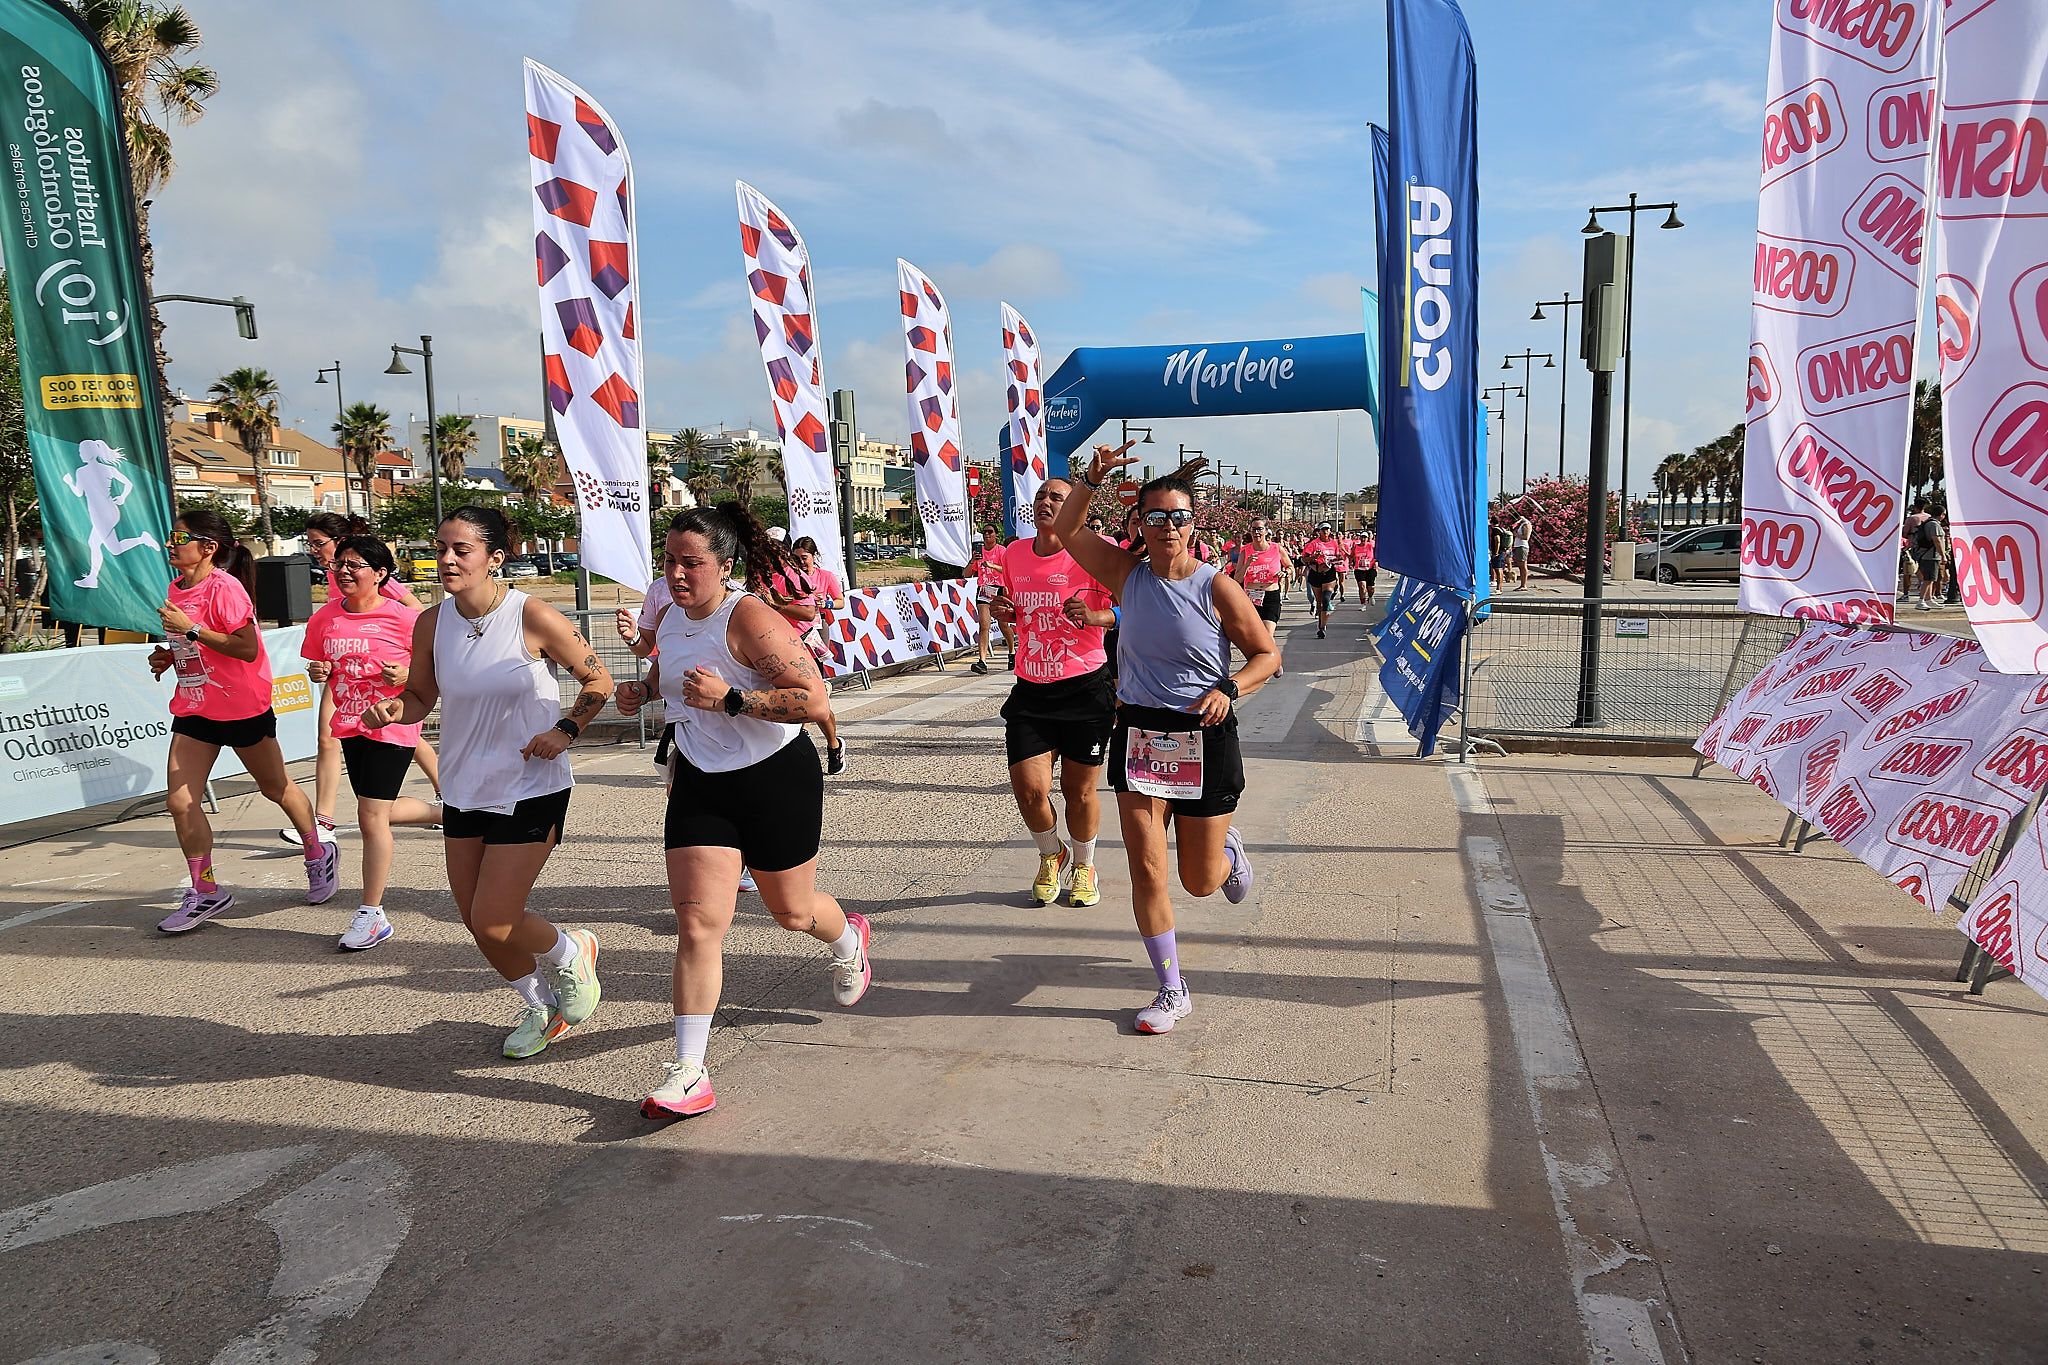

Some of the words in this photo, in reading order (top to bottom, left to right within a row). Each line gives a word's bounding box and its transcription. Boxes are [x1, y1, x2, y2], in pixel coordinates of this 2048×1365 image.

[1163, 346, 1294, 405] Marlene
[1039, 611, 1056, 632] DE
[1417, 605, 1452, 650] GOYA
[1024, 658, 1064, 678] MUJER
[1040, 642, 1054, 662] LA
[283, 680, 306, 693] 002
[1792, 667, 1858, 700] COSMO
[0, 702, 110, 733] Institutos
[1763, 714, 1825, 748] COSMO
[1874, 687, 1968, 742] COSMO
[4, 720, 168, 761] Odontológicos
[13, 766, 60, 782] Clínicas
[62, 756, 111, 774] dentales
[1150, 760, 1179, 773] 016
[1880, 742, 1963, 778] COSMO
[1819, 784, 1868, 843] COSMO
[1898, 799, 1999, 857] COSMO
